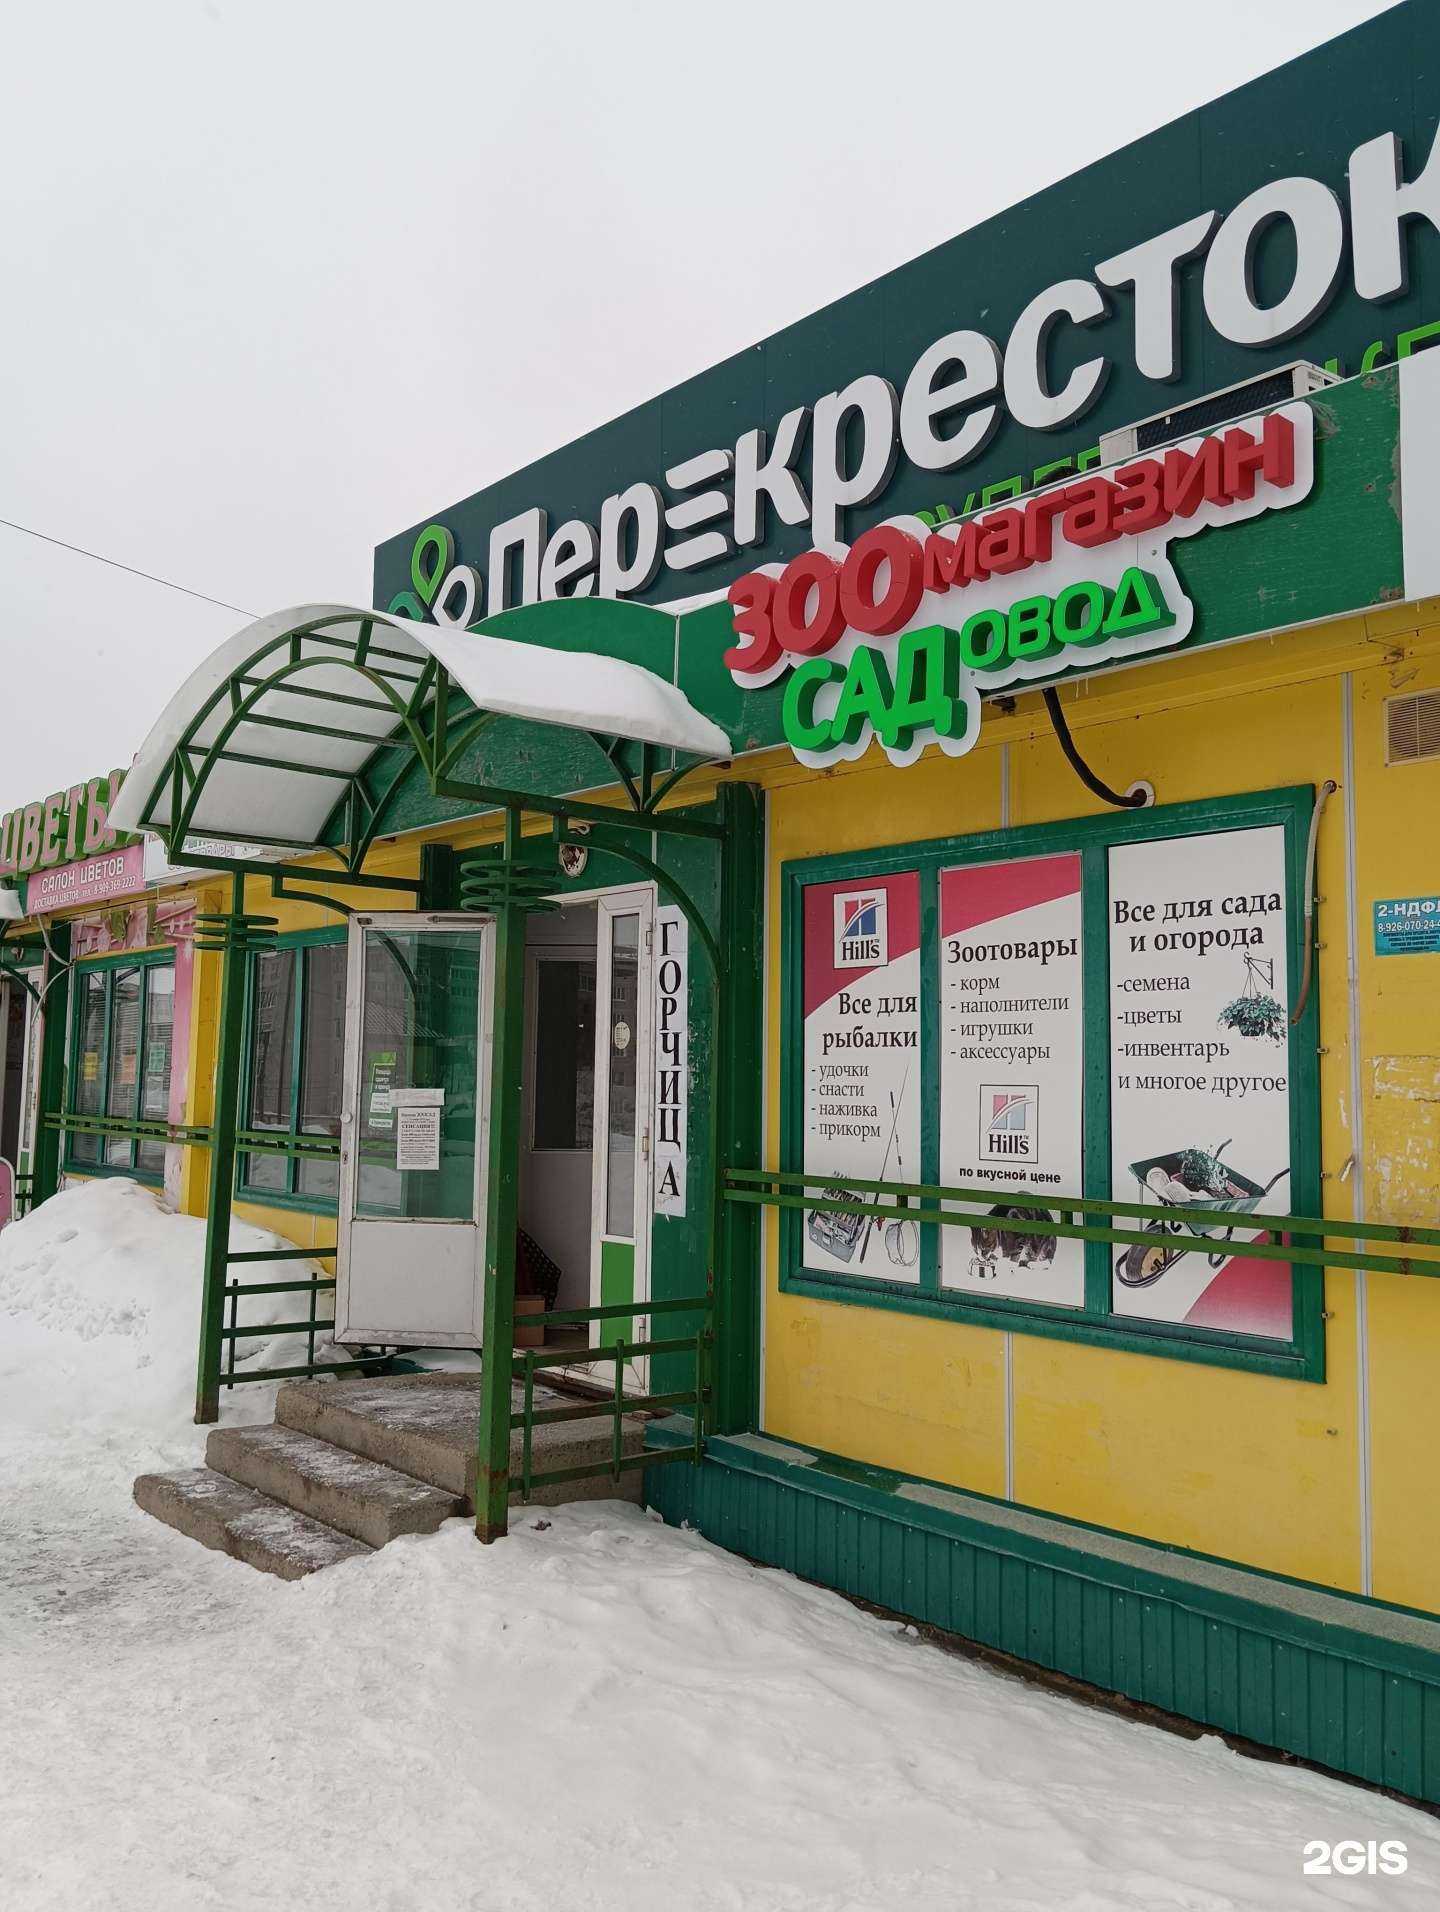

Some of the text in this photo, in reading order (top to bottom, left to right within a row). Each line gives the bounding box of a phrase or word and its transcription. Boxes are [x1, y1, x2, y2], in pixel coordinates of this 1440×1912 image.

[0, 768, 128, 877] ЦВЕТЫ
[41, 856, 124, 894] САЛОН ЦВЕТОВ
[1113, 892, 1282, 924] Все для сада
[1377, 919, 1440, 933] 8-926-070-24-
[842, 939, 880, 961] Hill's
[947, 938, 1078, 965] Зоотовары
[1130, 925, 1264, 956] и огорода
[960, 977, 1000, 995] корм
[838, 992, 918, 1018] Все для
[960, 997, 1070, 1013] наполнители
[822, 1025, 918, 1055] рыбалки
[960, 1022, 1033, 1041] игрушки
[658, 920, 682, 1198] ГОРЧИЦА
[960, 1046, 1051, 1065] аксессуары
[819, 1065, 869, 1082] удочки
[819, 1084, 865, 1097] снасти
[1118, 1075, 1287, 1098] и многое другое
[819, 1103, 878, 1117] наживка
[819, 1123, 881, 1142] прикорм
[988, 1133, 1030, 1155] Hill's
[959, 1167, 1061, 1184] по вкусной цене
